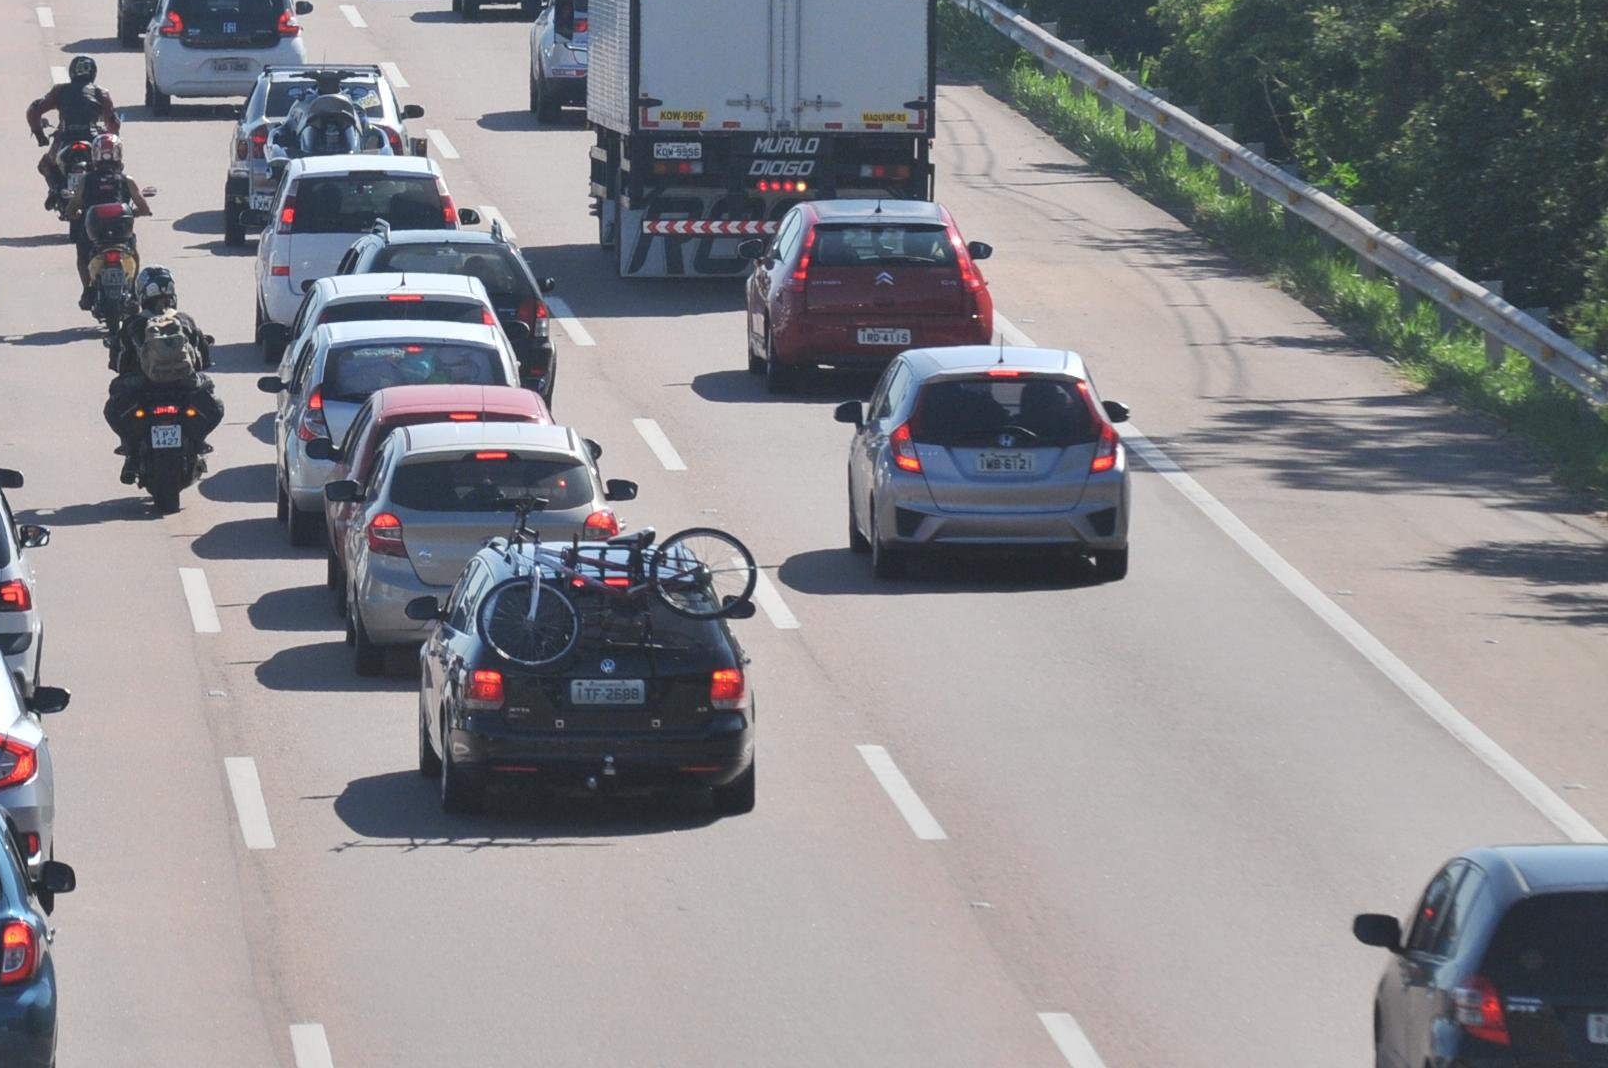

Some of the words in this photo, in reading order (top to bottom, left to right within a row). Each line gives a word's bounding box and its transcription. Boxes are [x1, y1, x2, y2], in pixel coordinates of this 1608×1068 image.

[660, 110, 705, 121] KOW-9996
[752, 137, 820, 154] MURILO
[748, 160, 816, 176] DIOGO
[155, 438, 179, 446] 4427
